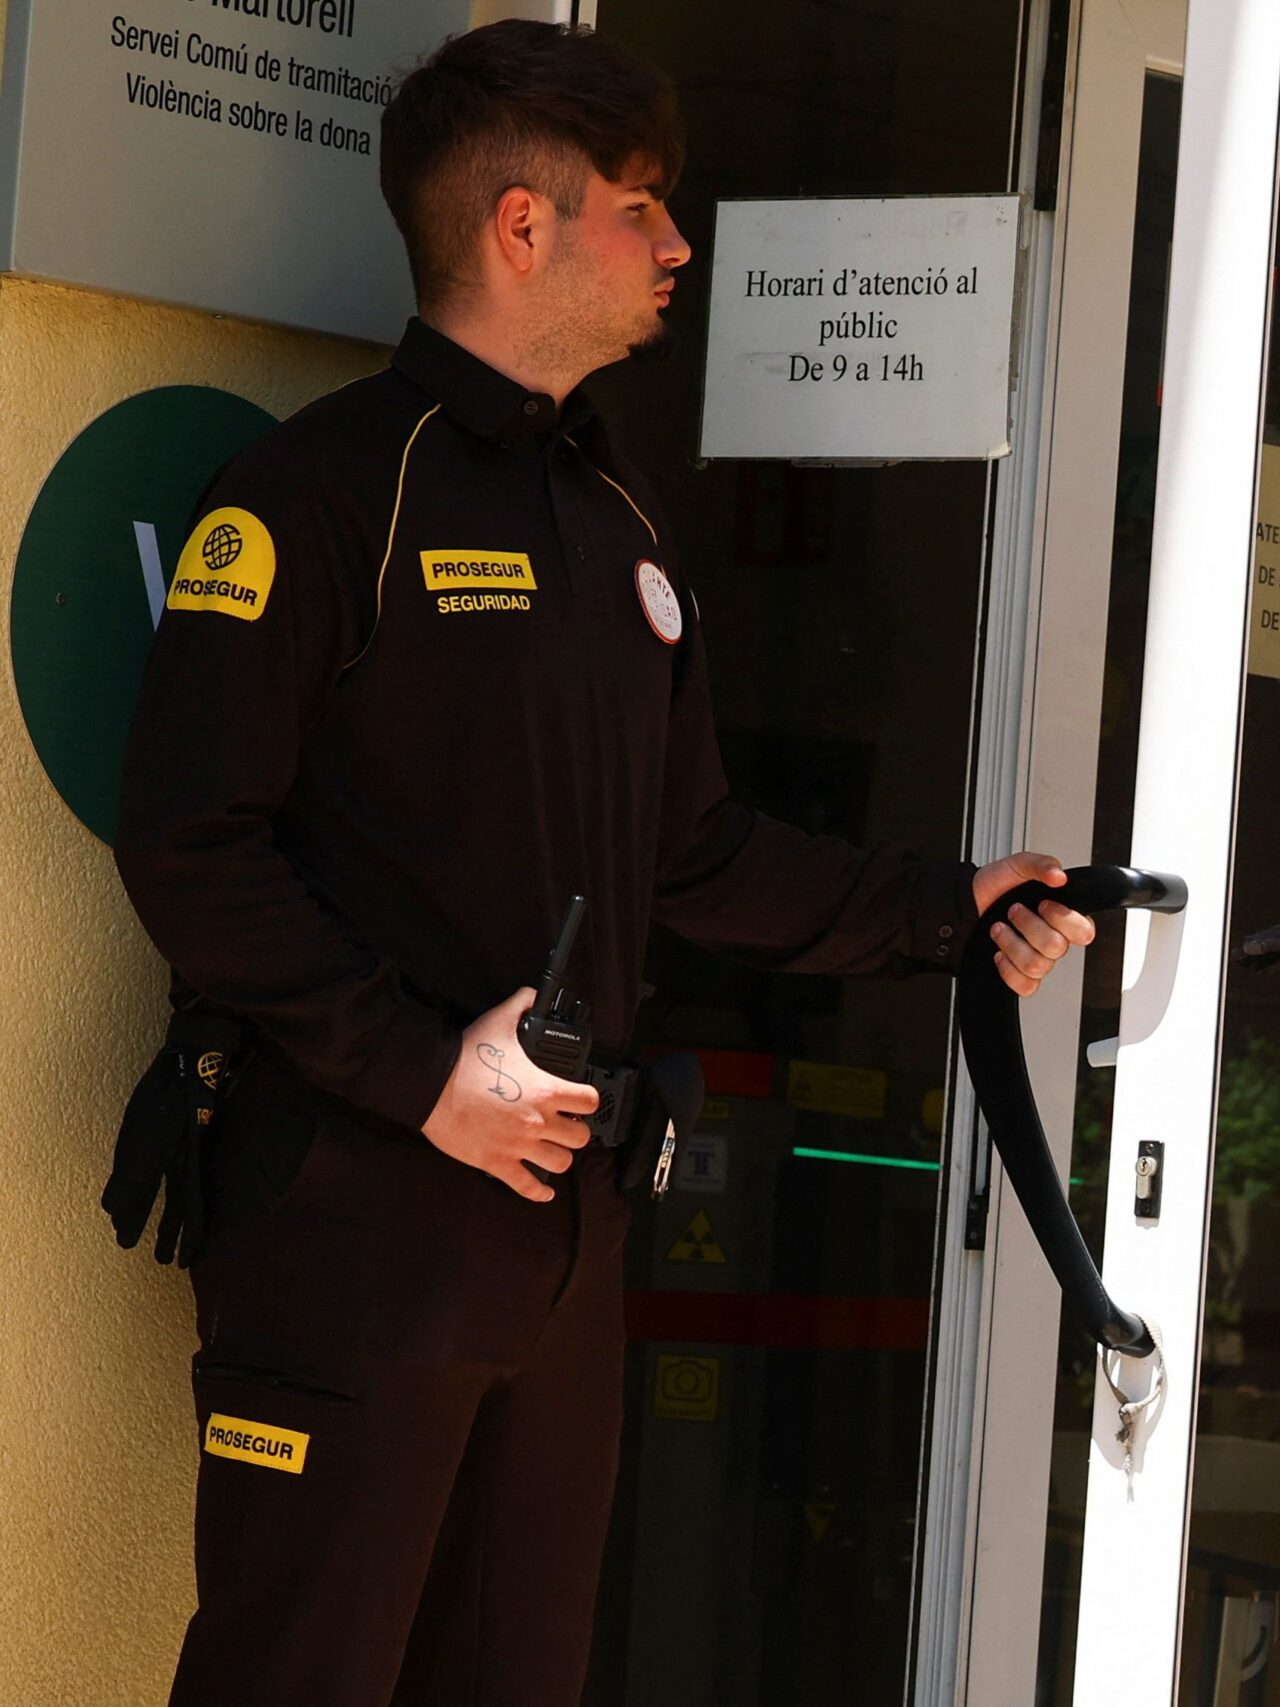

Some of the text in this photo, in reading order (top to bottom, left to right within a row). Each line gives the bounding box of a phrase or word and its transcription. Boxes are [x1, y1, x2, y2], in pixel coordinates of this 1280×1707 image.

[212, 0, 355, 37] artorell
[111, 16, 391, 106] Servei Comú de tramitació
[126, 73, 371, 155] Violència sobre la dona
[745, 269, 824, 297] Horari
[956, 267, 977, 294] al
[817, 312, 898, 346] públic
[788, 354, 924, 381] De 9 a 14h
[432, 562, 526, 578] PROSEGUR
[1258, 565, 1275, 586] DE
[174, 579, 258, 606] PROSEGUR
[437, 594, 531, 613] SEGURIDAD
[1261, 609, 1280, 630] DE
[544, 1029, 581, 1041] MOTOROLA
[210, 1426, 293, 1460] PROSEGUR
